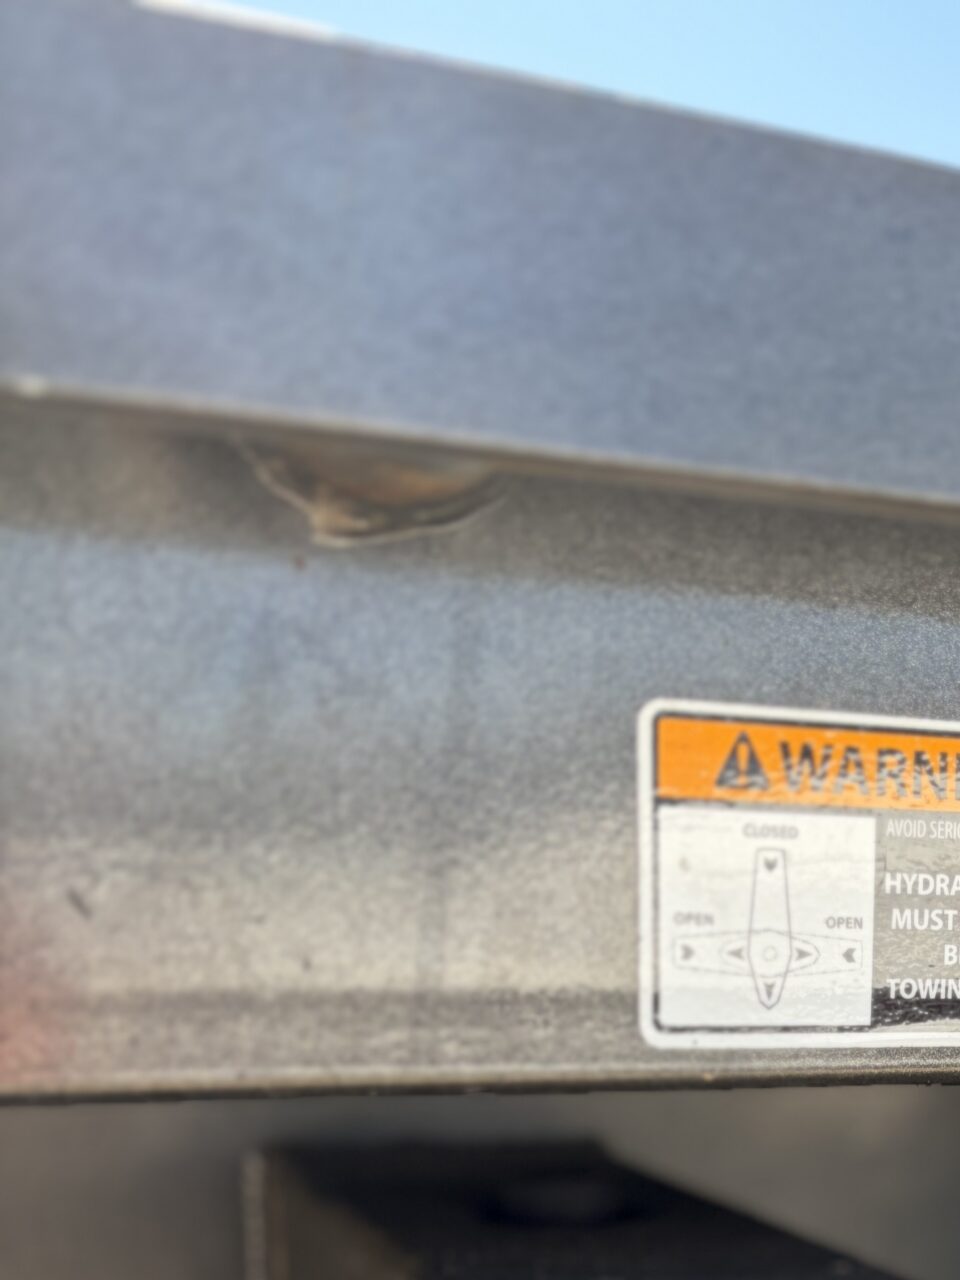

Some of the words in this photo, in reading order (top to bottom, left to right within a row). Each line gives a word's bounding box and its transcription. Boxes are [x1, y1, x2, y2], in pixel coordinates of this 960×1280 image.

[742, 822, 799, 840] CLOSED
[886, 819, 926, 838] AVOID
[673, 911, 715, 926] OPEN
[825, 916, 864, 930] OPEN
[891, 908, 958, 930] MUST
